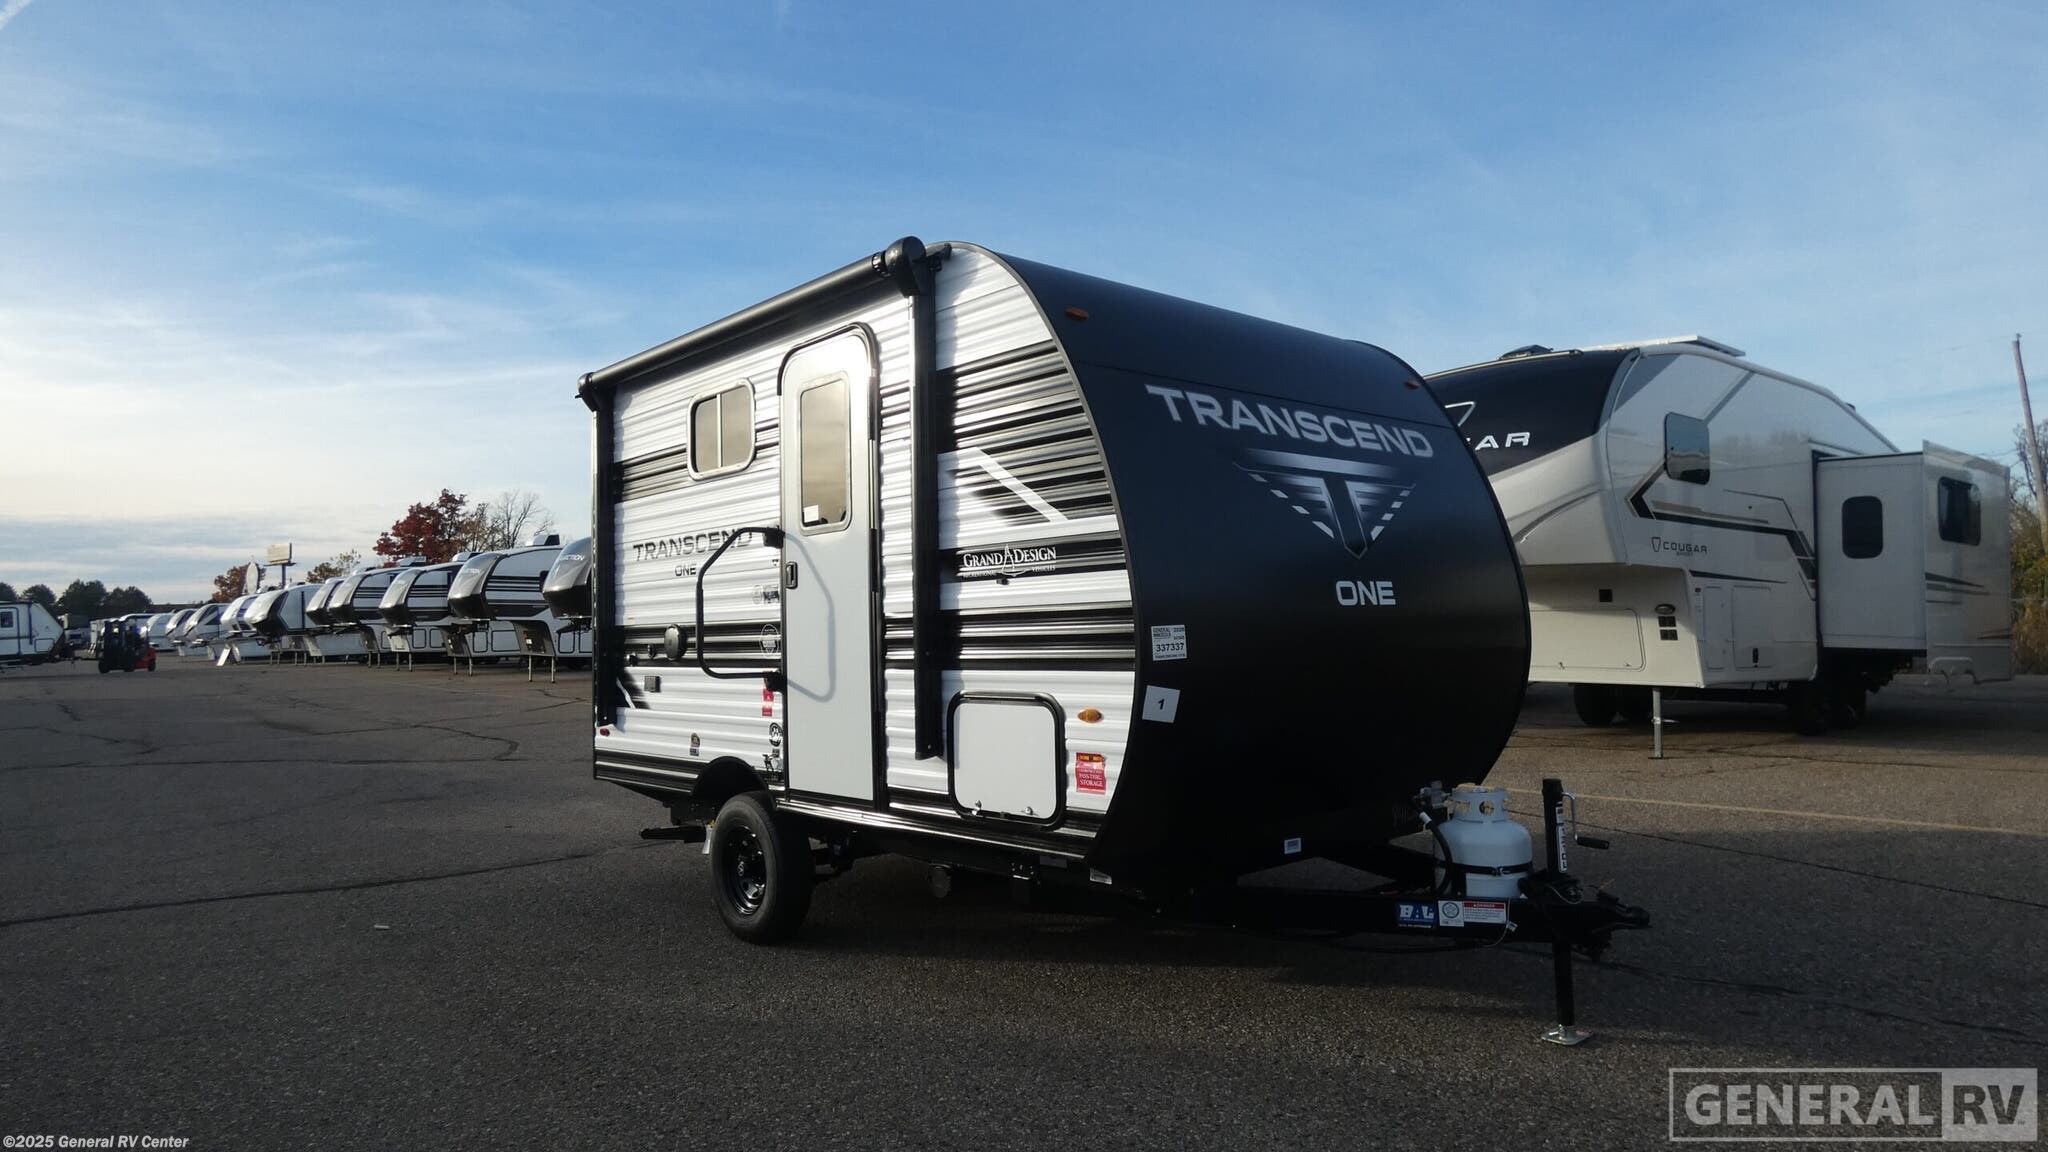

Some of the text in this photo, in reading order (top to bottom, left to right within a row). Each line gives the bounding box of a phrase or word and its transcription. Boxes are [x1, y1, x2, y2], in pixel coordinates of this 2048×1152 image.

[1145, 384, 1434, 458] TRANSCEND
[1663, 541, 1708, 555] COUGAR
[963, 547, 1057, 568] GRAND DESIGN
[675, 564, 697, 577] ONE
[1335, 580, 1396, 606] ONE
[1156, 643, 1185, 652] 337337
[1158, 698, 1165, 710] 1
